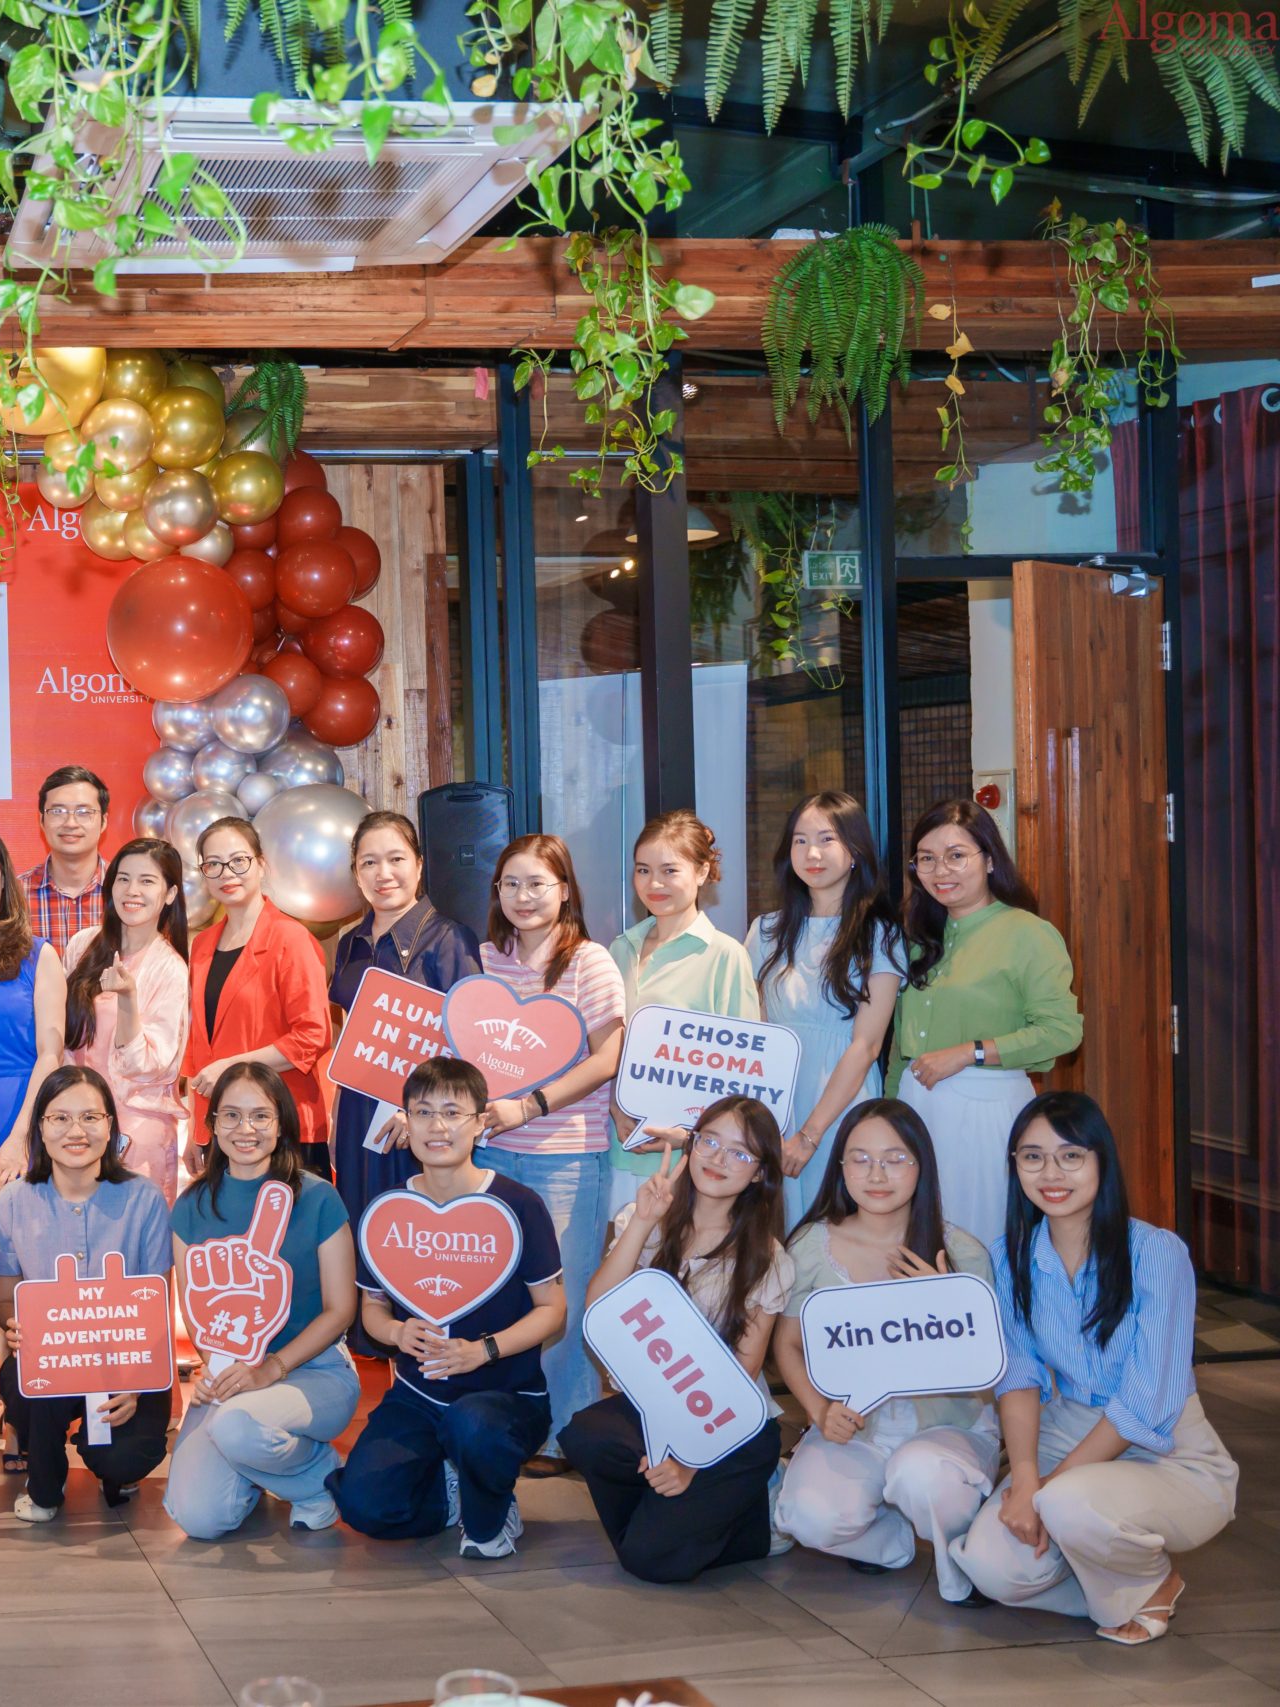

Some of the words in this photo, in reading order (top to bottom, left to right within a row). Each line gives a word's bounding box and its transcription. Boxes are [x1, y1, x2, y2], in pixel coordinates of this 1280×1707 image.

[26, 505, 80, 540] Alg
[35, 666, 137, 702] Algom
[372, 992, 443, 1032] ALUM
[372, 1019, 401, 1044] IN
[663, 1020, 671, 1036] I
[679, 1023, 767, 1052] CHOSE
[476, 1051, 525, 1076] Algoma
[654, 1043, 765, 1078] ALGOMA
[629, 1063, 785, 1105] UNIVERSITY
[381, 1221, 498, 1258] Algoma
[434, 1253, 496, 1264] UNIVERSITY
[78, 1287, 105, 1301] MY
[46, 1305, 139, 1322] CANADIAN
[209, 1309, 249, 1346] #1
[823, 1325, 874, 1350] Xin
[880, 1312, 976, 1344] Chào!
[41, 1328, 147, 1346] ADVENTURE
[38, 1353, 103, 1369] STARTS
[106, 1350, 152, 1366] HERE
[620, 1298, 736, 1435] Hello!
